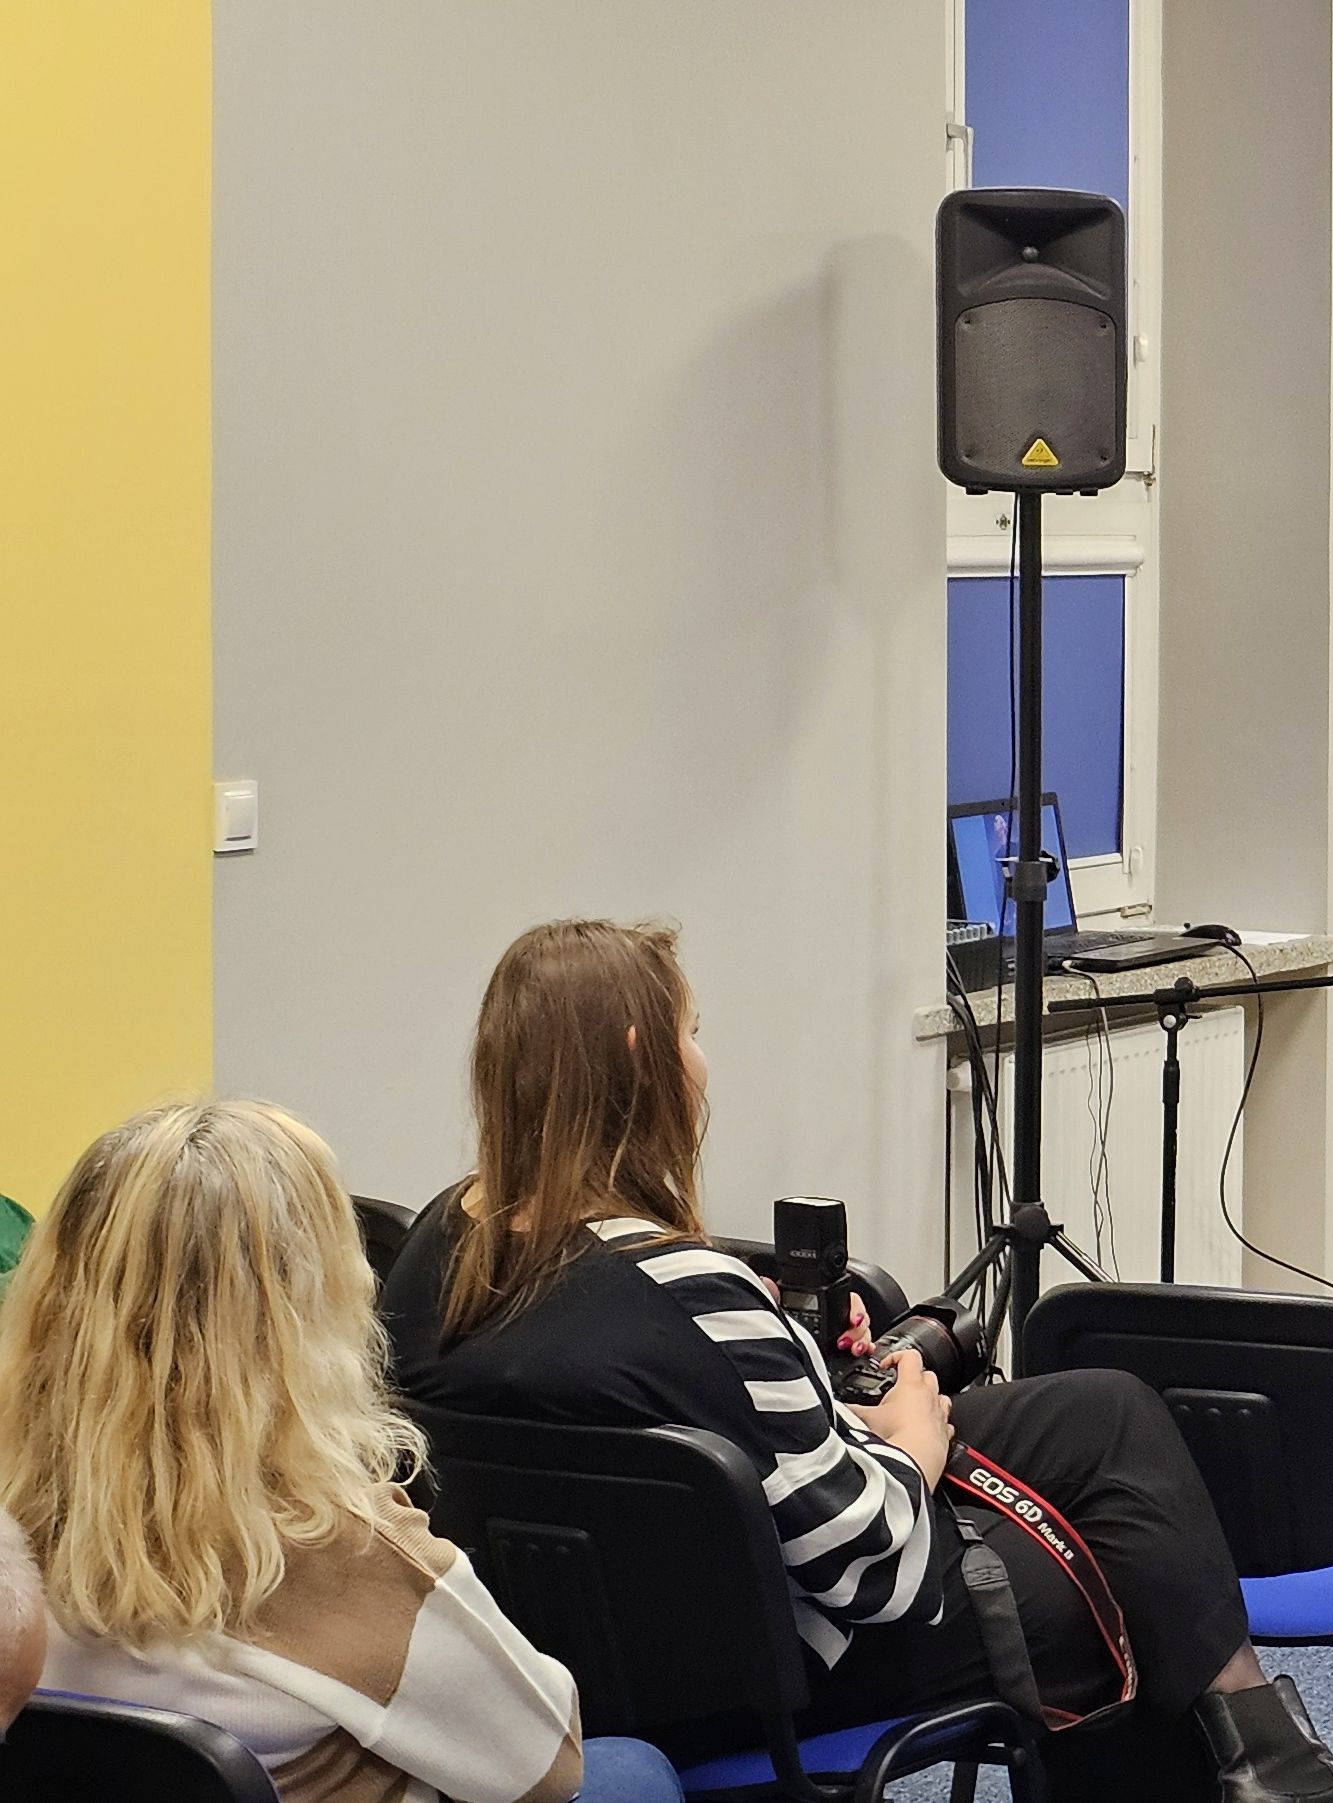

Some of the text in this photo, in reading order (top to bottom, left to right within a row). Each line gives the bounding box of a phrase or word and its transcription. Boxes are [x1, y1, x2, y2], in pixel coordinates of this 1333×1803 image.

[969, 1468, 1020, 1504] EOS
[1014, 1499, 1043, 1523] 6D
[1037, 1522, 1067, 1553] Mark
